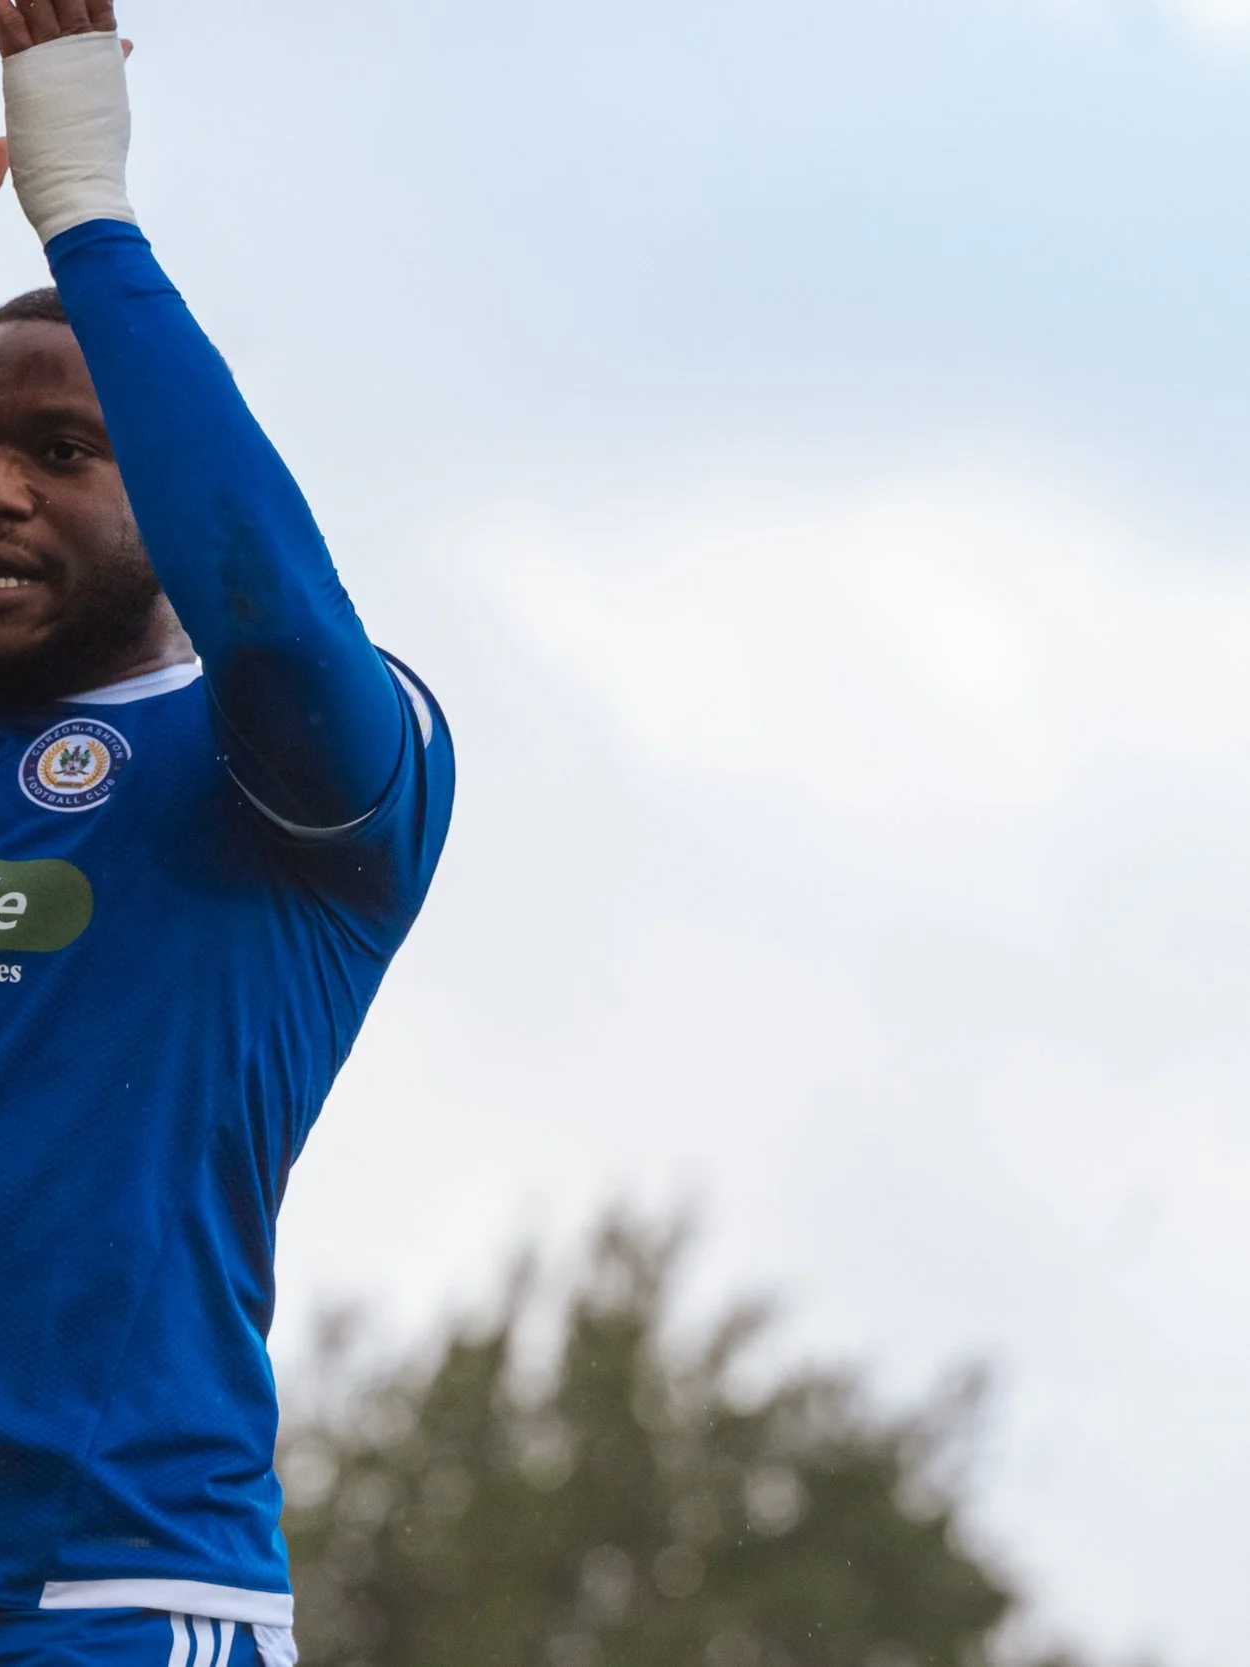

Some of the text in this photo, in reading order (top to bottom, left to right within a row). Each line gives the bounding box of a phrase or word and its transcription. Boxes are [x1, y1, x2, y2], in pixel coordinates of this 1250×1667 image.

[31, 724, 125, 760] CURZON ASHTON
[26, 775, 116, 805] FOOTBALL CLUB
